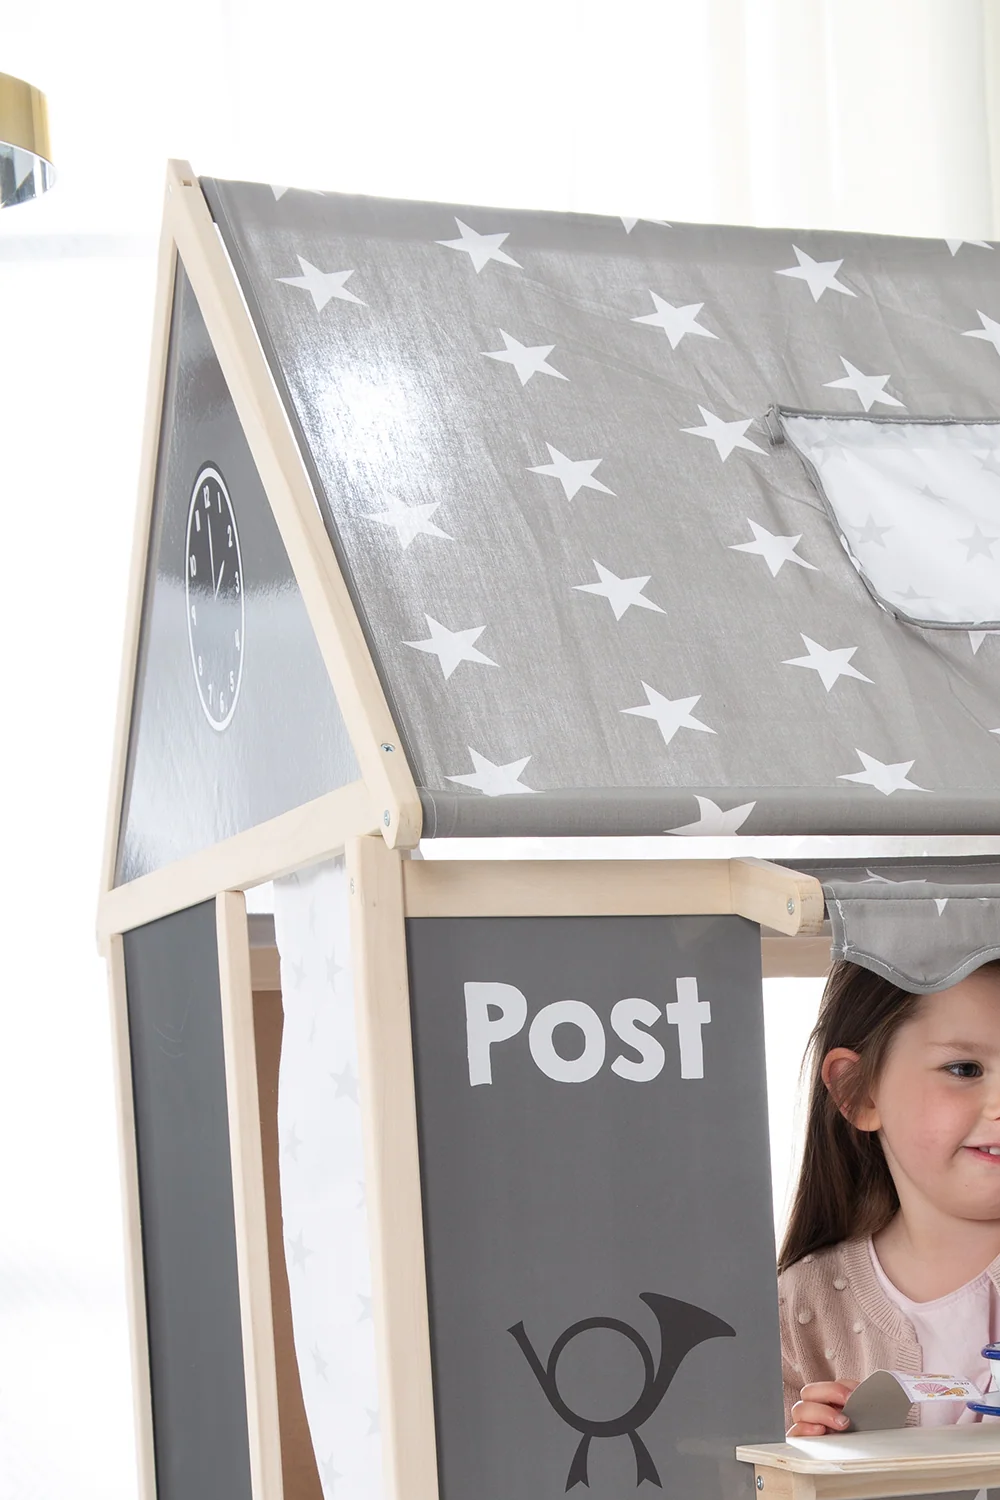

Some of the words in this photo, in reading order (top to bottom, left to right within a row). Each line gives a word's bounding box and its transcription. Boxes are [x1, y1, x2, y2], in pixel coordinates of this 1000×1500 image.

[202, 484, 211, 509] 12
[227, 525, 233, 548] 2
[189, 554, 197, 578] 10
[464, 977, 711, 1086] Post
